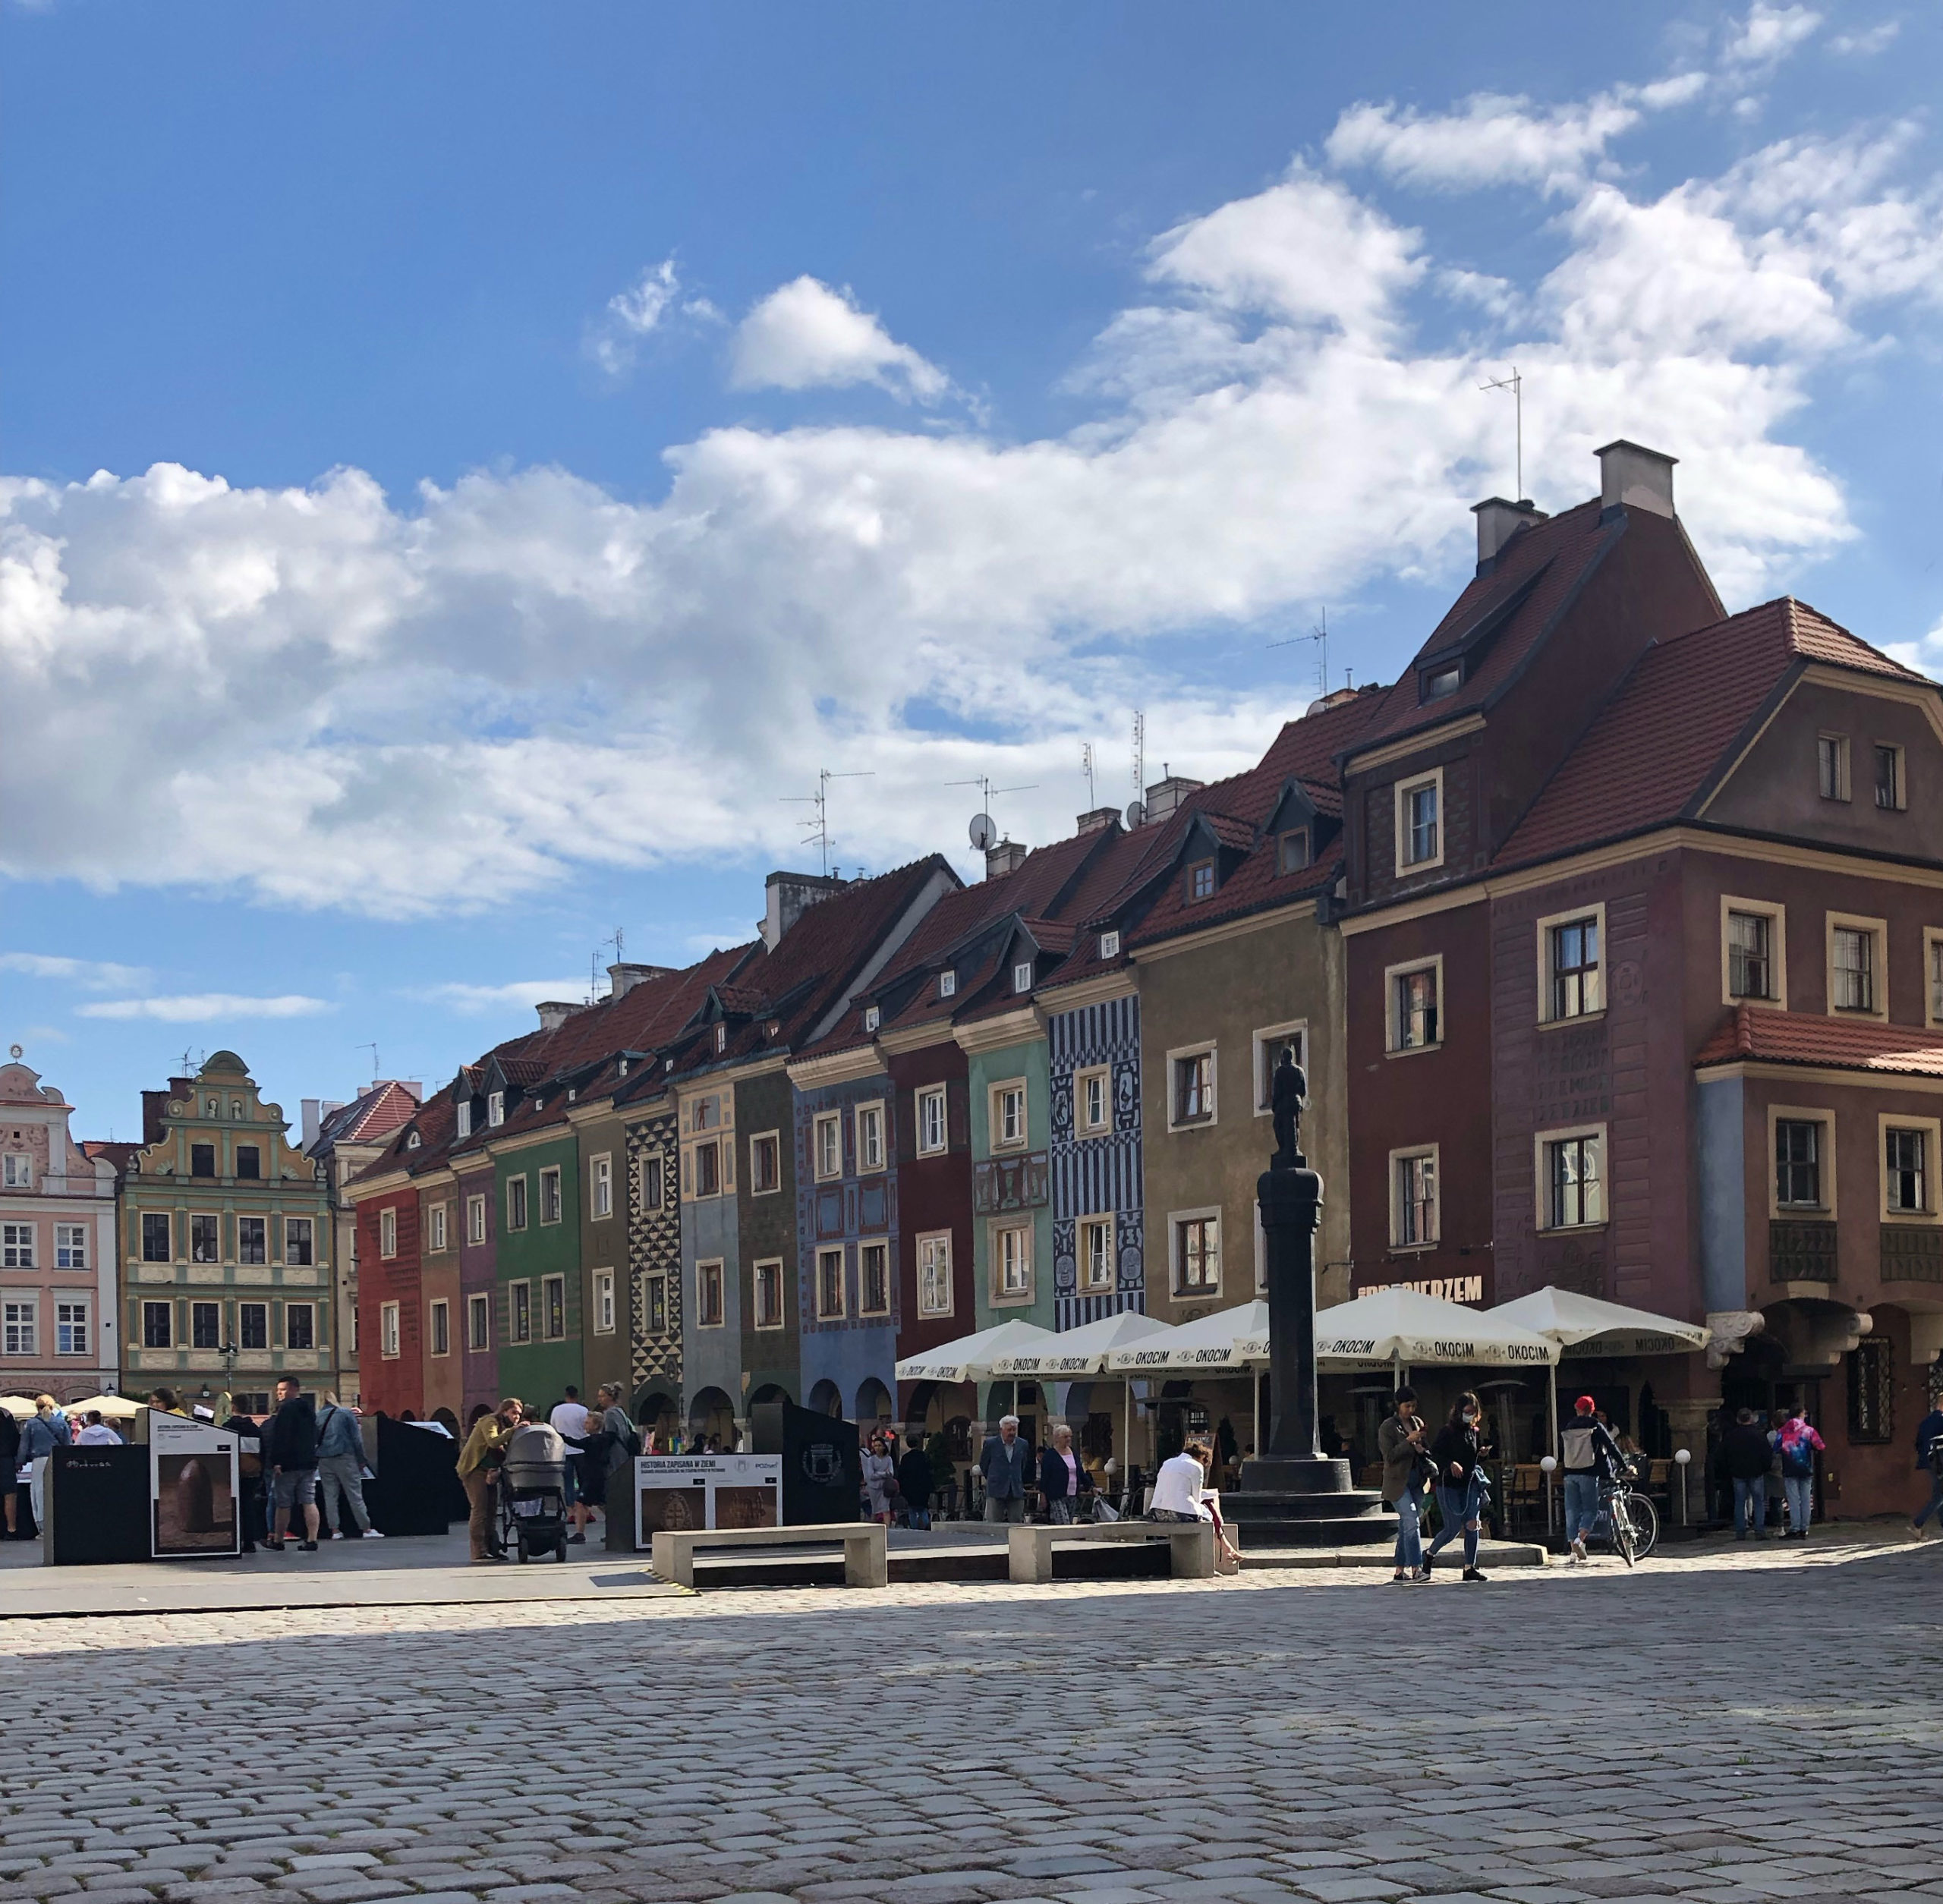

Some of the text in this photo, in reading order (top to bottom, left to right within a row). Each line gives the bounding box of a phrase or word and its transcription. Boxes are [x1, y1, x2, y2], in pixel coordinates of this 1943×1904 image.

[1332, 1339, 1375, 1355] OKOCIM
[1434, 1341, 1475, 1358] OKOCIM
[1507, 1344, 1550, 1361] OKOCIM
[1135, 1351, 1170, 1364] OKOCIM
[1195, 1349, 1232, 1363] OKOCIM
[1012, 1358, 1041, 1371] OKOCIM
[1060, 1358, 1089, 1371] OKOCIM
[667, 1460, 694, 1468] ZAPISANA
